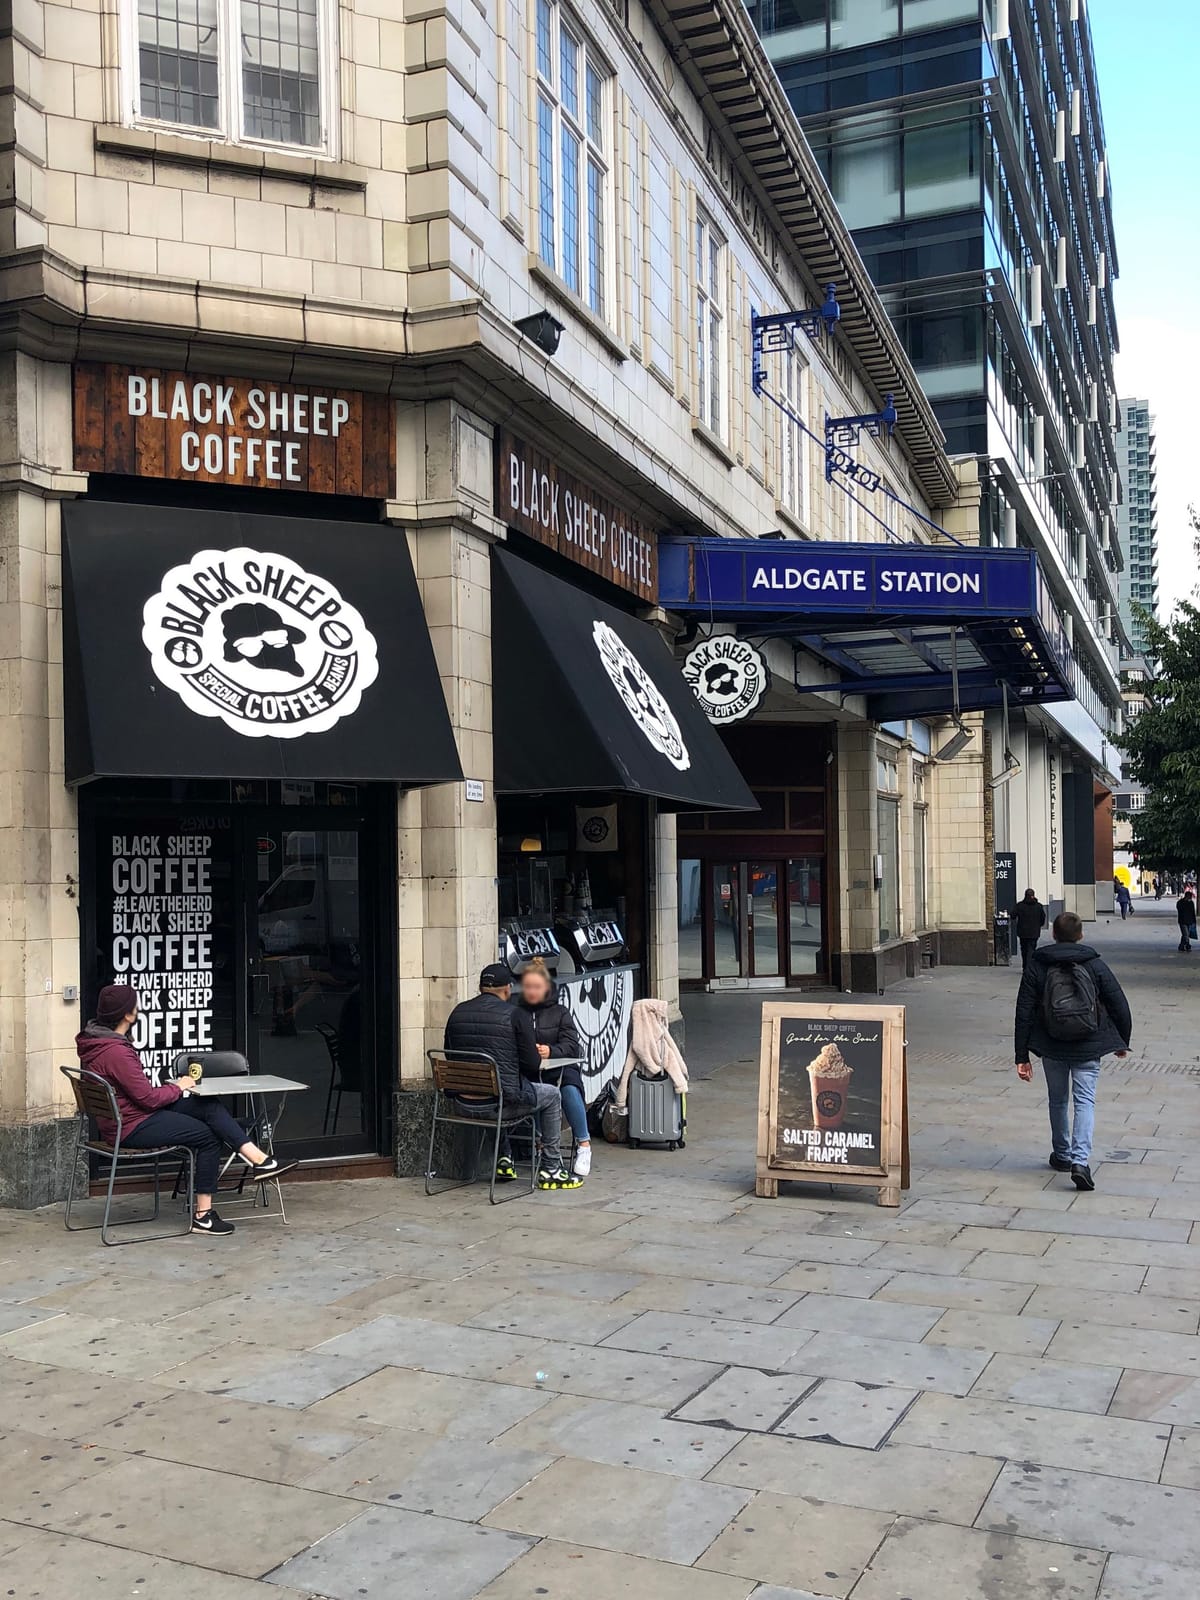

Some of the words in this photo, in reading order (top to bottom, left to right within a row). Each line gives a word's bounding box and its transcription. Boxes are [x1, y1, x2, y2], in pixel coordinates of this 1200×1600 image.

[128, 375, 235, 426] BLACK
[247, 388, 349, 437] SHEEP
[181, 431, 302, 482] COFFEE
[510, 452, 560, 535] BLACK
[564, 490, 607, 559] SHEEP
[610, 520, 652, 588] COFFEE
[752, 566, 867, 591] ALDGATE
[880, 570, 980, 594] STATION
[160, 561, 245, 638] BLACK
[243, 560, 342, 621] SHEEP
[685, 646, 715, 684] BLACK
[715, 641, 752, 664] SHEEP
[198, 671, 242, 708] SPECIAL
[245, 685, 329, 721] COFFEE
[323, 656, 349, 692] BEANS
[714, 696, 748, 717] COFFEE
[112, 836, 161, 856] BLACK
[167, 836, 212, 856] SHEEP
[113, 858, 212, 894] COFFEE
[113, 895, 213, 912] #LEAVETHEHERD
[113, 913, 161, 933] BLACK
[167, 912, 213, 932] SHEEP
[113, 934, 213, 972] COFFEE
[136, 990, 161, 1010] ACK
[168, 988, 213, 1009] SHEEP
[131, 1010, 213, 1049] OFFEE
[590, 1010, 619, 1071] COFFEE
[786, 1032, 813, 1045] Good
[813, 1034, 830, 1043] for
[833, 1034, 850, 1042] the
[853, 1032, 878, 1044] Soul
[807, 1023, 822, 1031] BLACK
[783, 1128, 821, 1146] SALTED
[825, 1131, 875, 1149] CARAMEL
